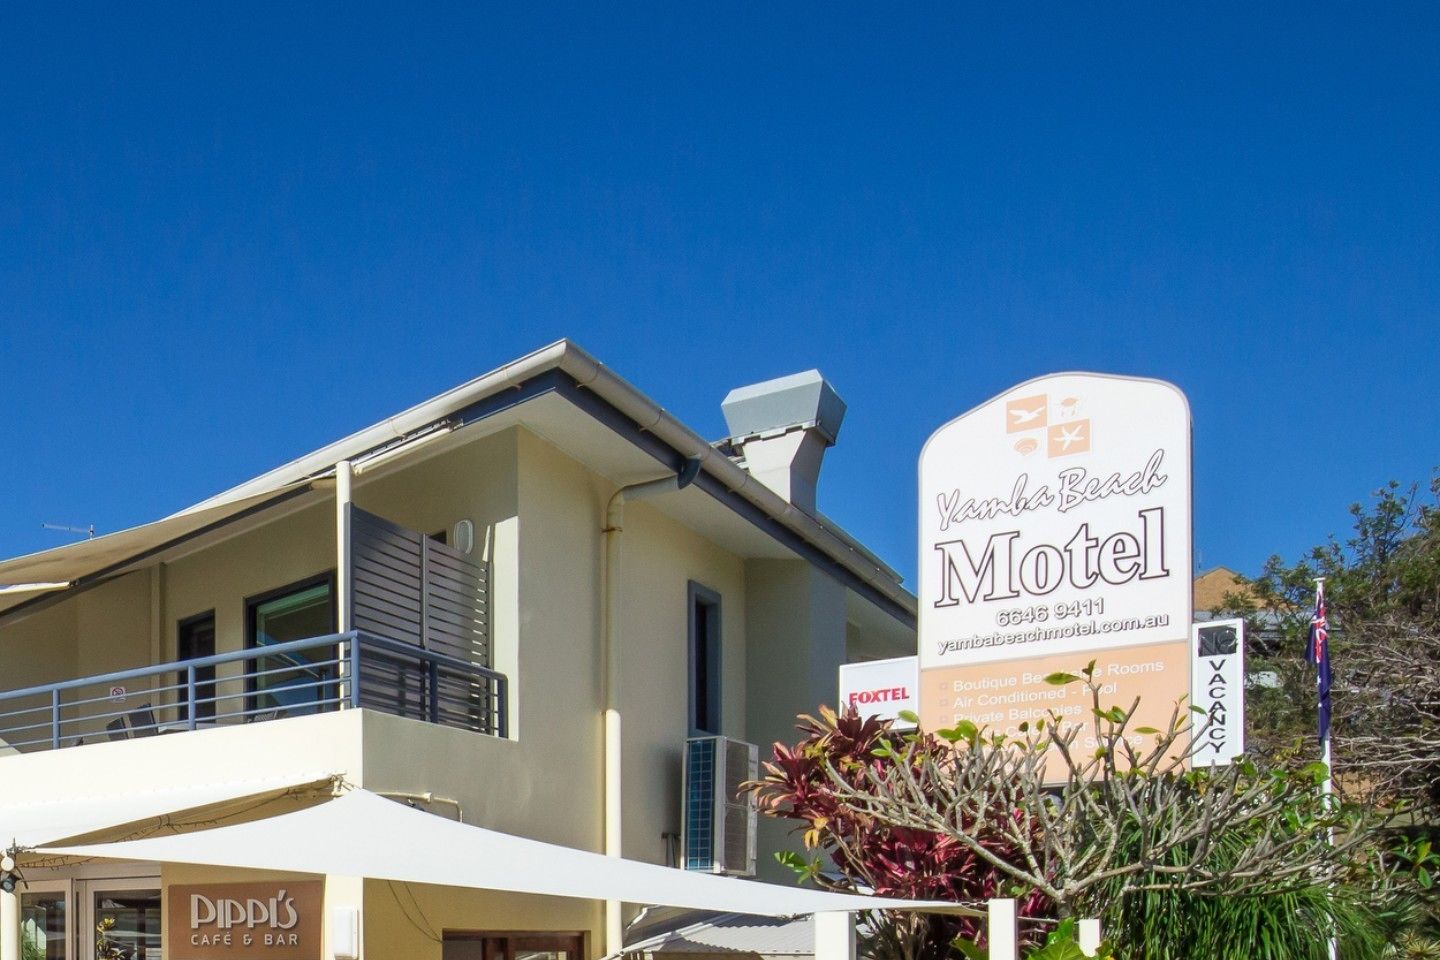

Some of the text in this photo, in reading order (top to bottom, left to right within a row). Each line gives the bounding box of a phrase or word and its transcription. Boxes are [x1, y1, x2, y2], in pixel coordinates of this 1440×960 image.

[937, 448, 1168, 531] Yamba Beach
[934, 507, 1170, 608] Motel
[996, 597, 1105, 627] 6646 9411
[938, 613, 1169, 655] yambabeachmotel.com.au
[954, 677, 1017, 692] Boutique
[1108, 661, 1165, 676] Rooms
[849, 687, 910, 706] FOXTEL
[954, 697, 972, 709] Air
[978, 687, 1067, 706] Conditioned
[1208, 659, 1227, 753] VACANCY
[1009, 704, 1083, 720] Balconies
[191, 931, 298, 946] CAFÉ & BAR
